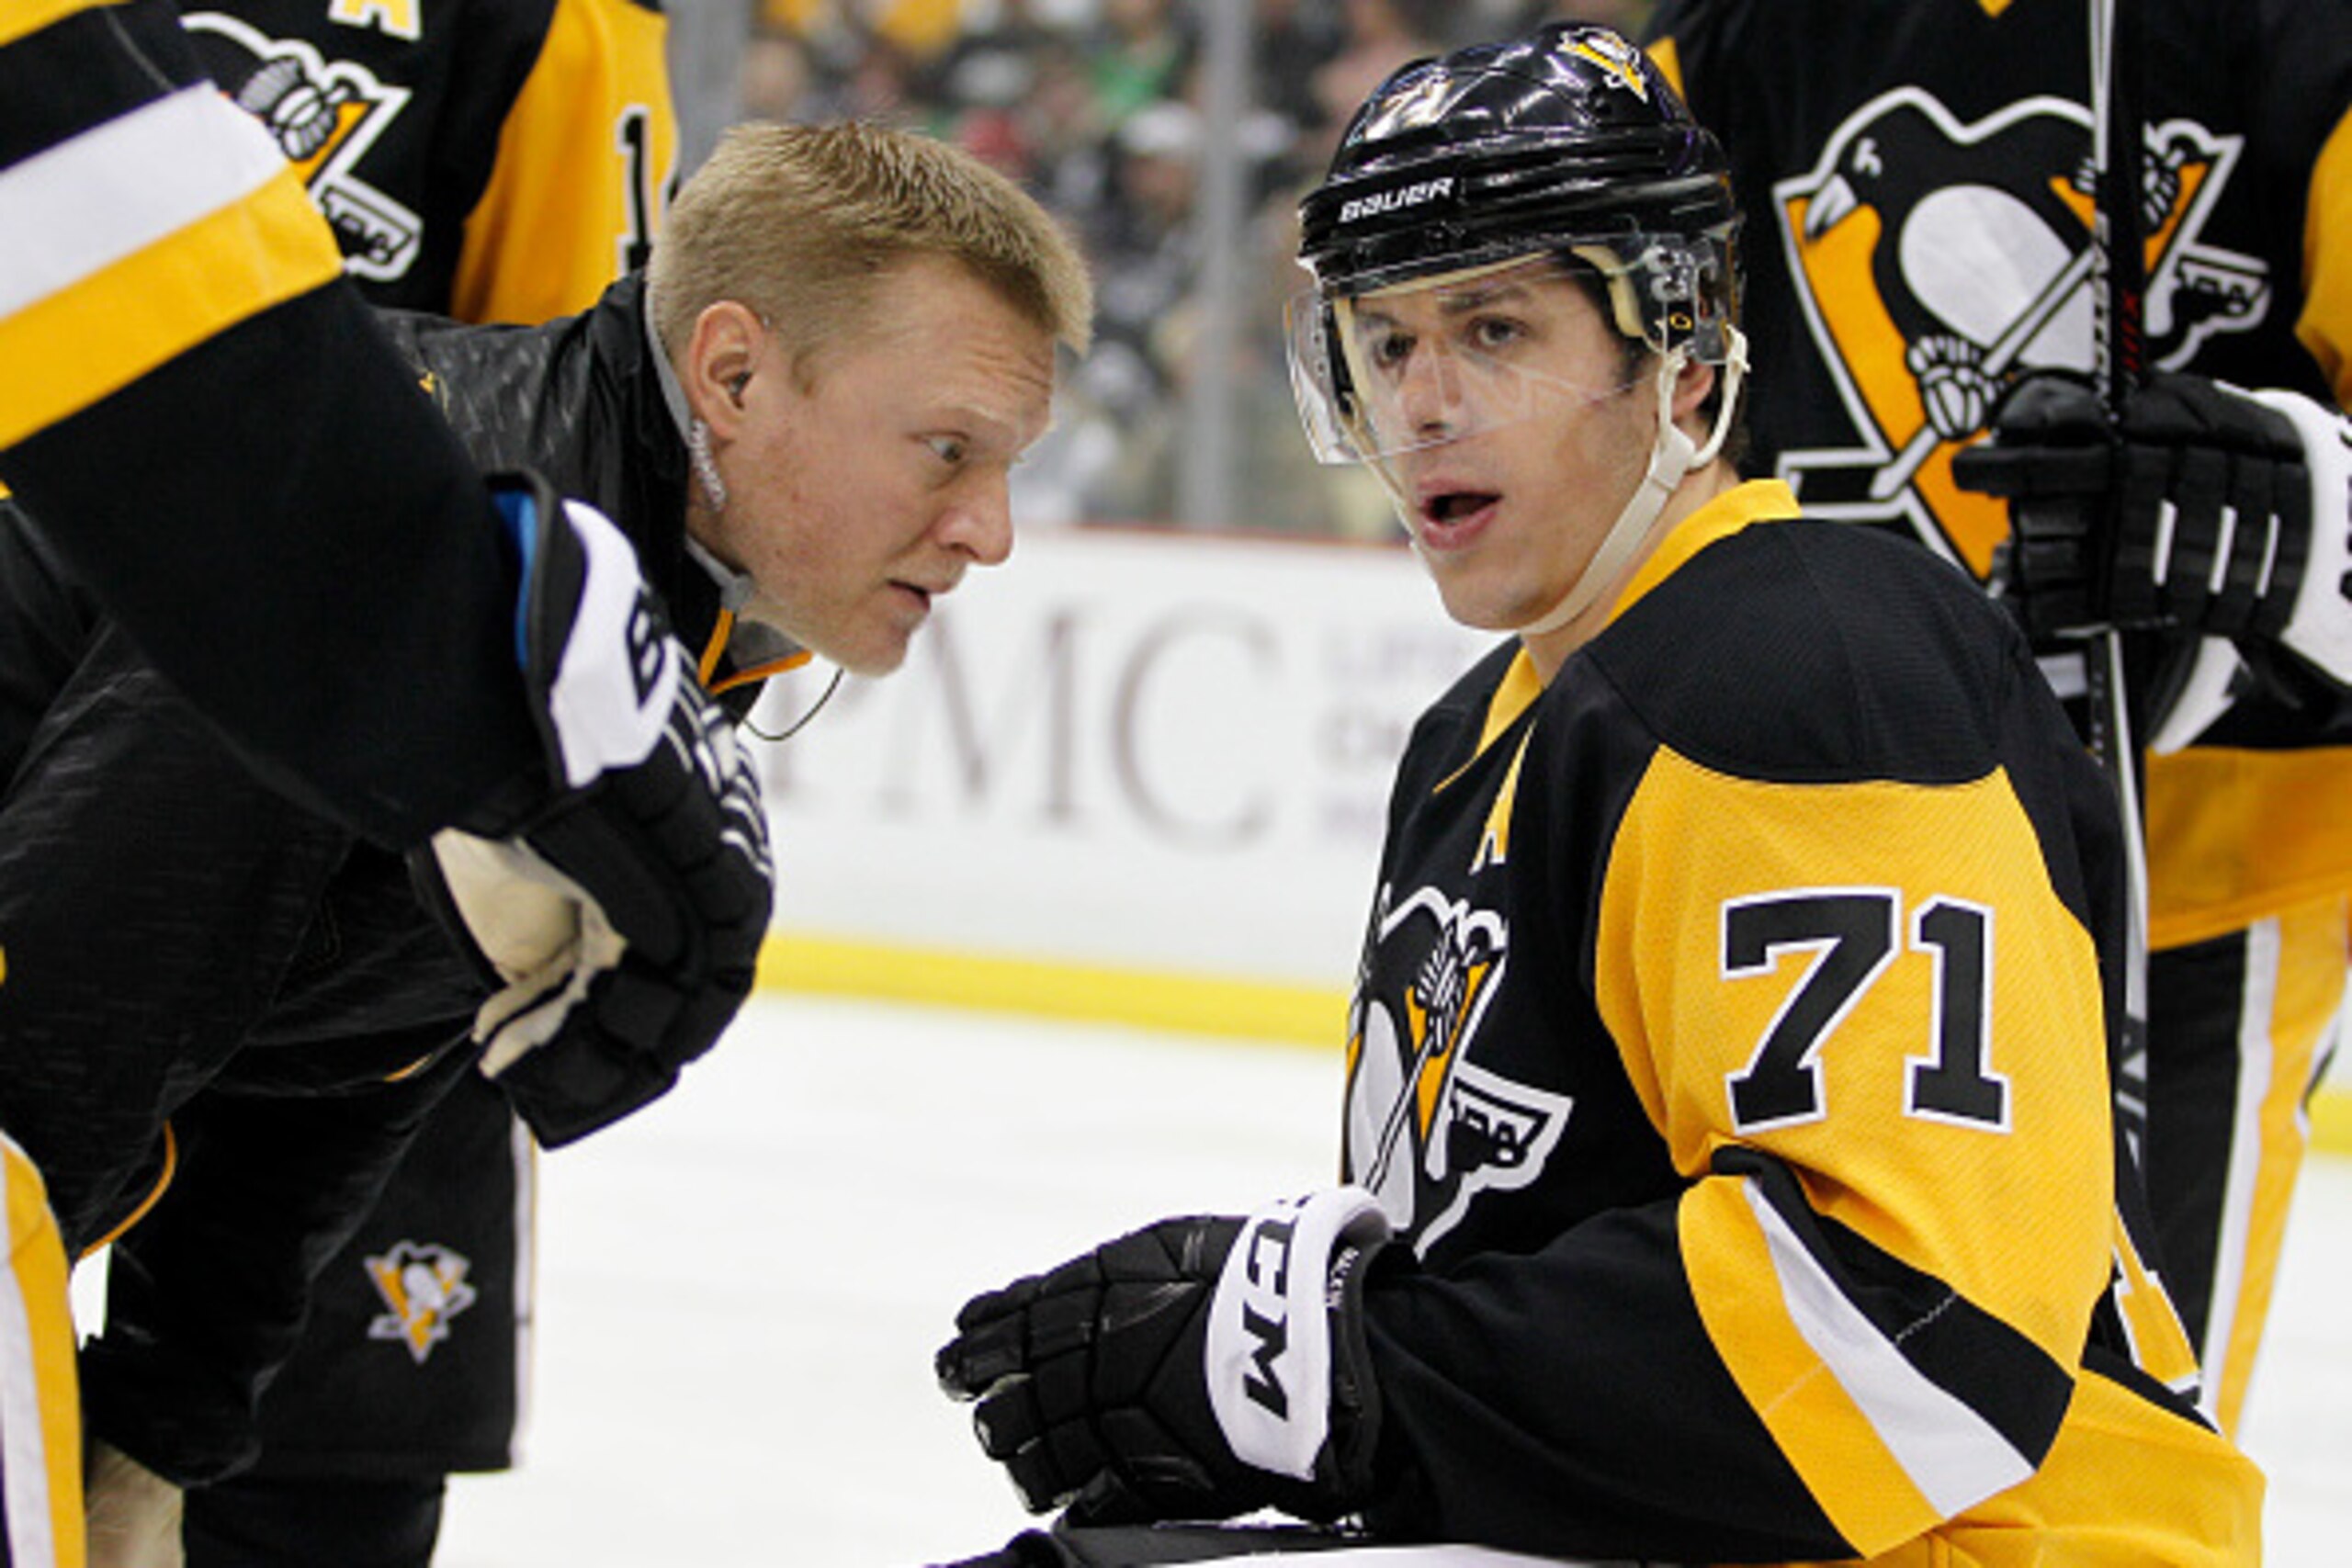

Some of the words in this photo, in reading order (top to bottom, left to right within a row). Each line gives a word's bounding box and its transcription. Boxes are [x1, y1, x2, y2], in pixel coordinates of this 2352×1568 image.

[1339, 177, 1454, 223] BAUER
[1719, 885, 2012, 1135] 71
[1242, 1192, 1310, 1422] CM
